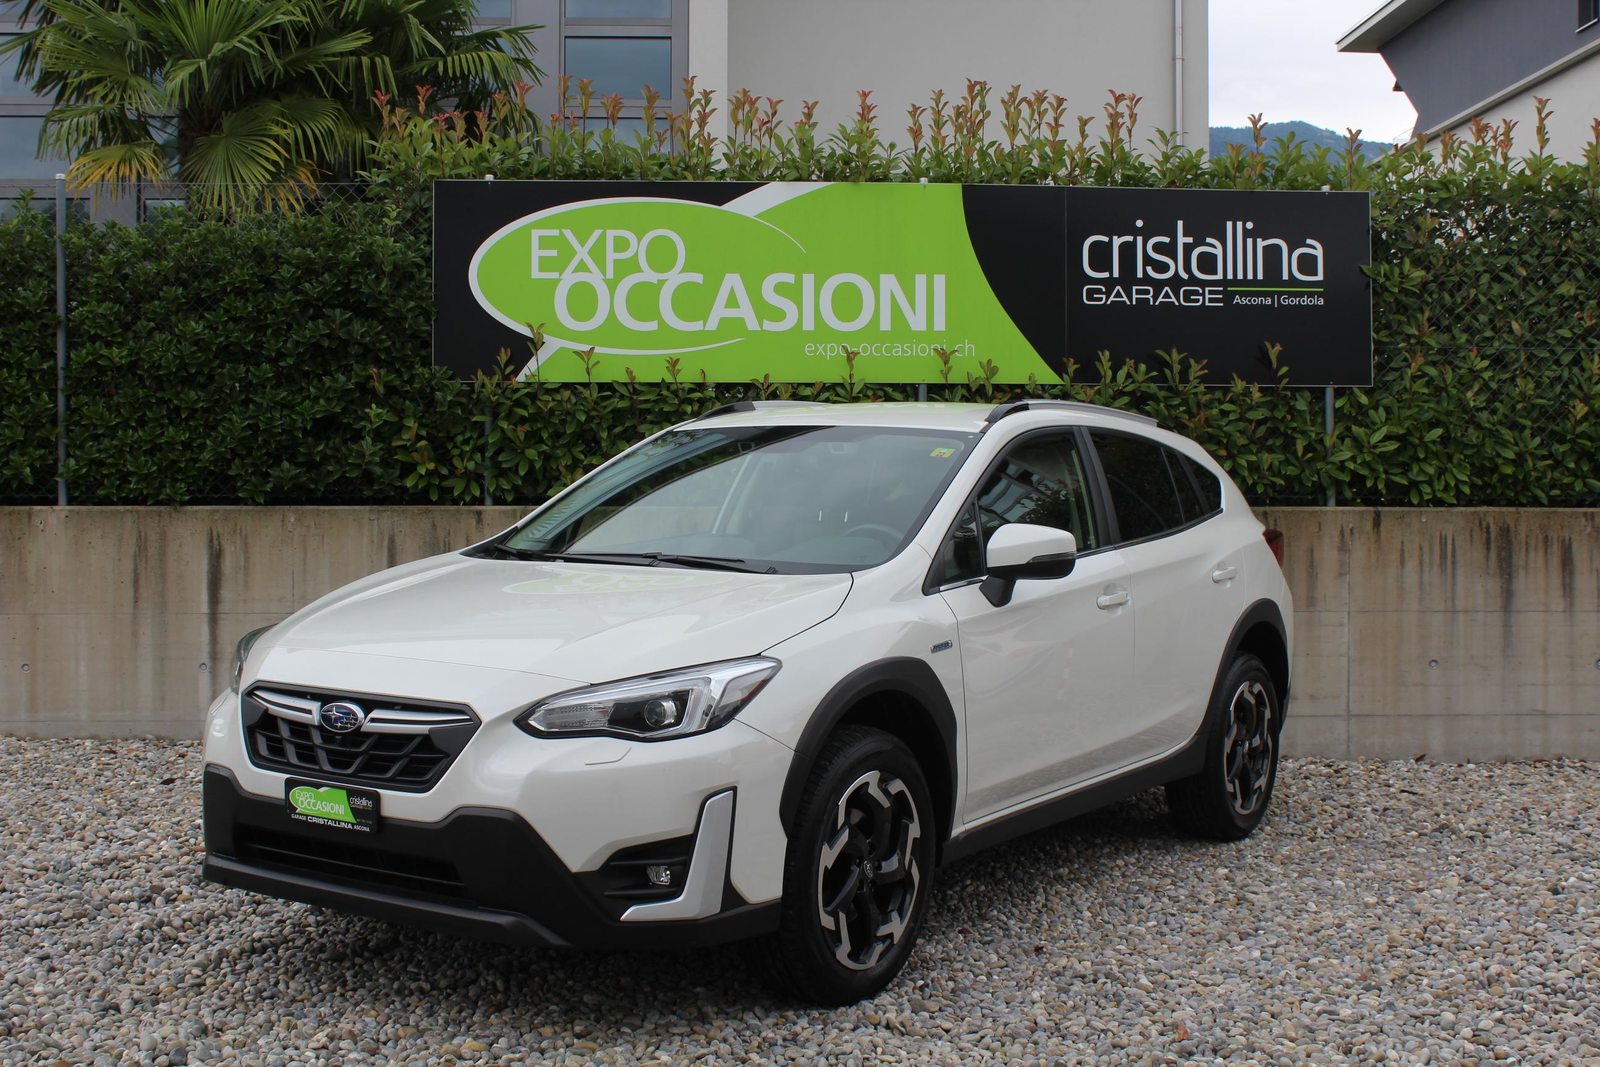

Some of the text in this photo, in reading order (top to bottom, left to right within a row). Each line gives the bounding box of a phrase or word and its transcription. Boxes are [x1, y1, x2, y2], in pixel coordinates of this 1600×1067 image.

[531, 229, 686, 280] EXPO
[1082, 219, 1324, 281] cristallina
[554, 272, 946, 332] OCCASIONI
[1083, 286, 1223, 306] GARAGE
[1233, 295, 1272, 305] Ascona
[1280, 295, 1324, 305] Gordola
[805, 340, 975, 360] expo-occasionich
[295, 790, 314, 799] EXPO
[298, 798, 346, 815] OCCASIONI
[291, 813, 307, 821] GARAGE
[307, 816, 353, 829] CRISTALLINA
